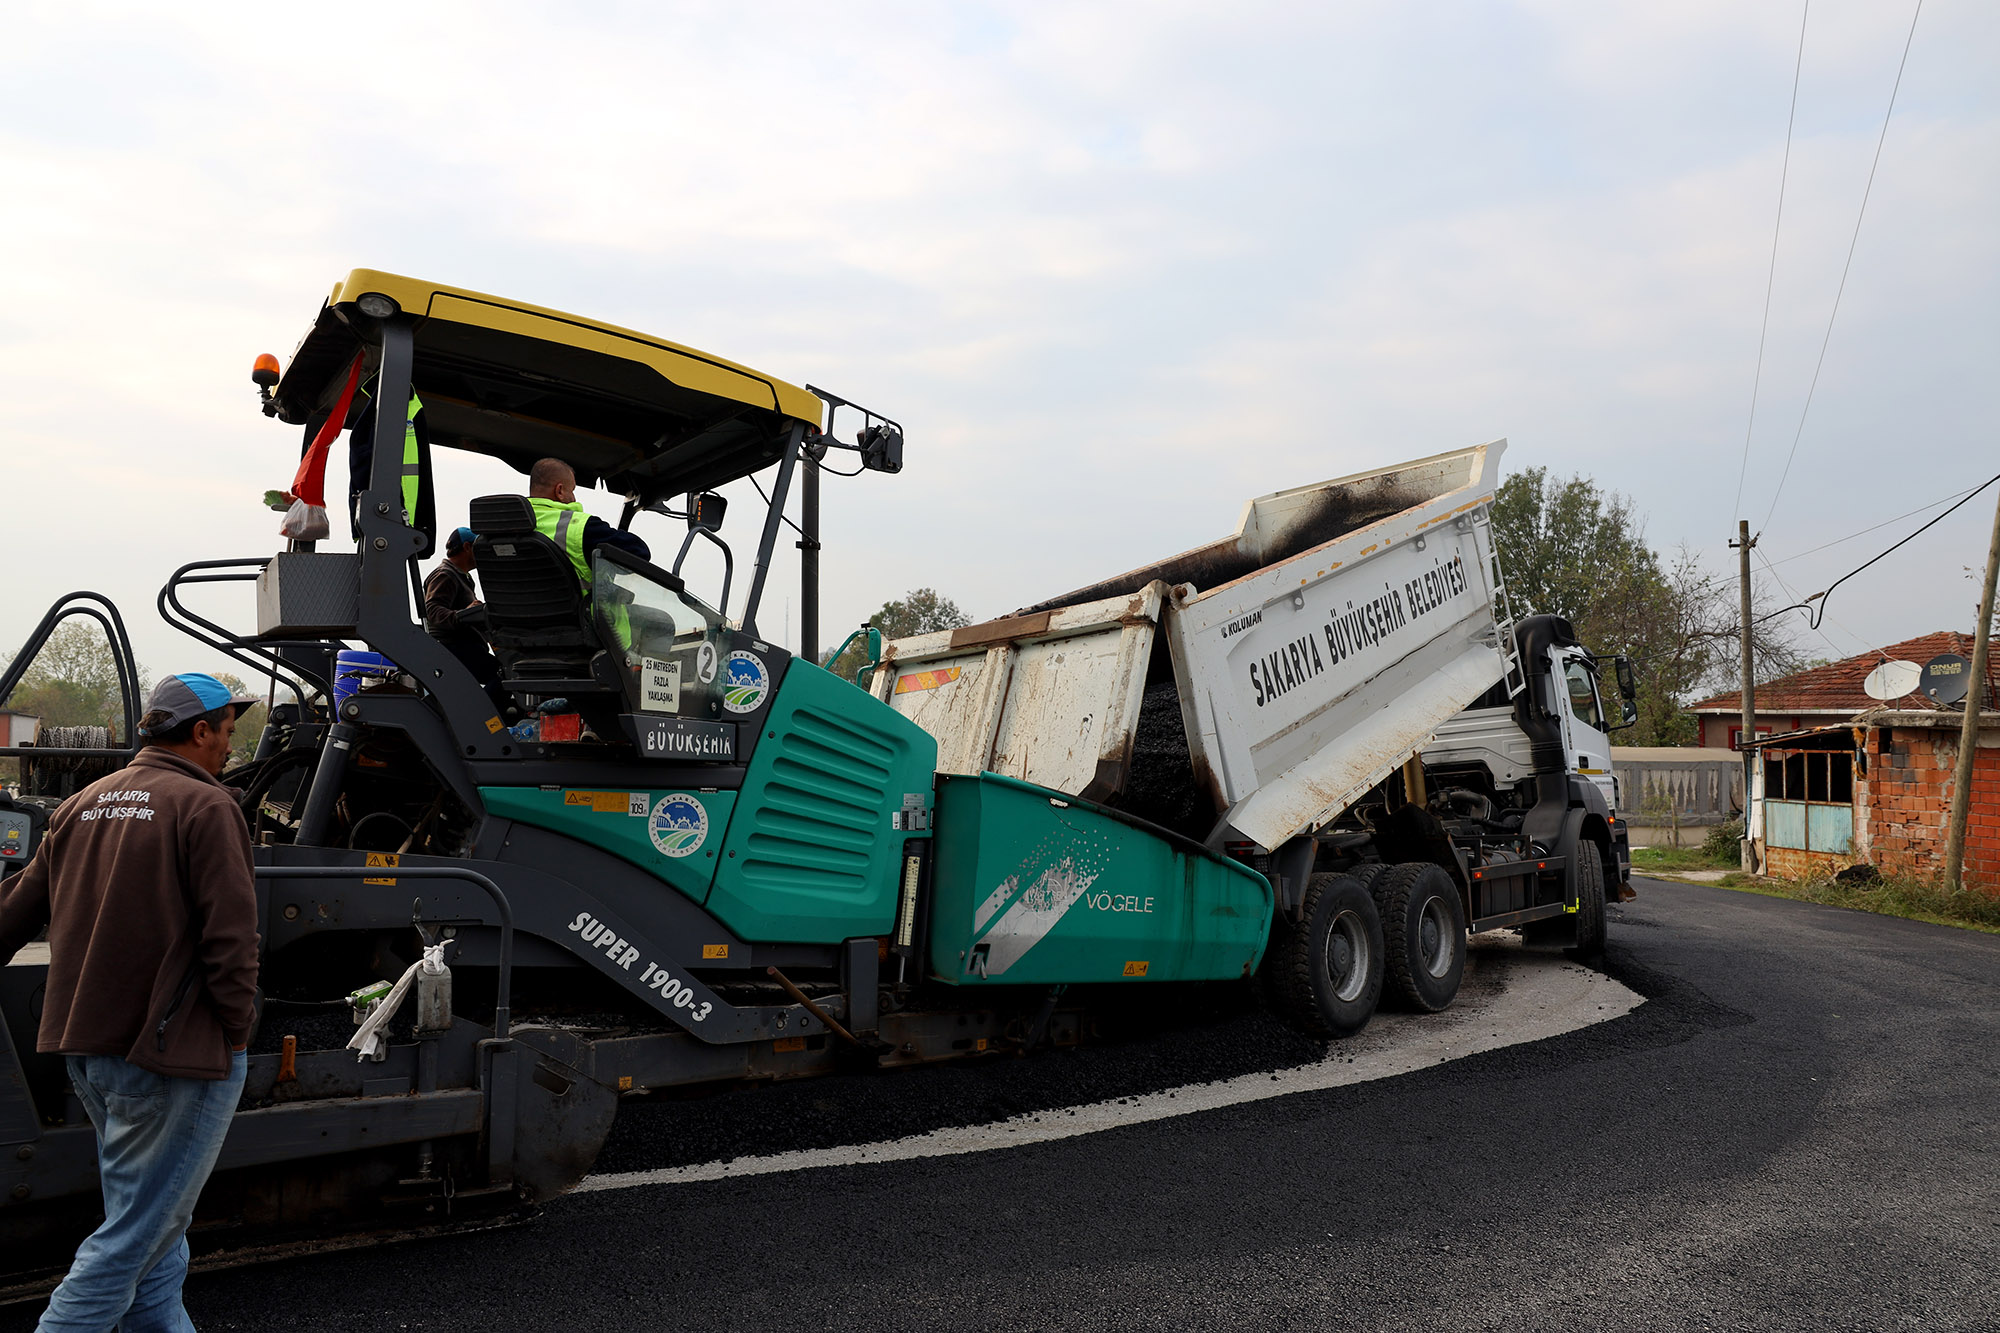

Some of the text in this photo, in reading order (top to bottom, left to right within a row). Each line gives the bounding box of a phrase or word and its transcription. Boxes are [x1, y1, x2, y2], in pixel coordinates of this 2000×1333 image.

[1228, 610, 1262, 637] KOLUMAN
[1249, 547, 1468, 708] SAKARYA BÜYÜKŞEHİR BELEDİYESİ
[646, 659, 678, 674] 25 METREDEN
[701, 646, 714, 680] 2
[1930, 662, 1962, 670] ONUR
[653, 676, 669, 687] FAZLA
[647, 690, 673, 704] YAKLAŞMA
[647, 722, 732, 756] BÜYÜKŞEHİR
[97, 790, 151, 803] SAKARYA
[81, 805, 155, 821] BÜYÜKŞEHİR
[631, 803, 644, 815] 109
[1086, 889, 1154, 913] VÖGELE
[567, 912, 713, 1022] SUPER 1900-3
